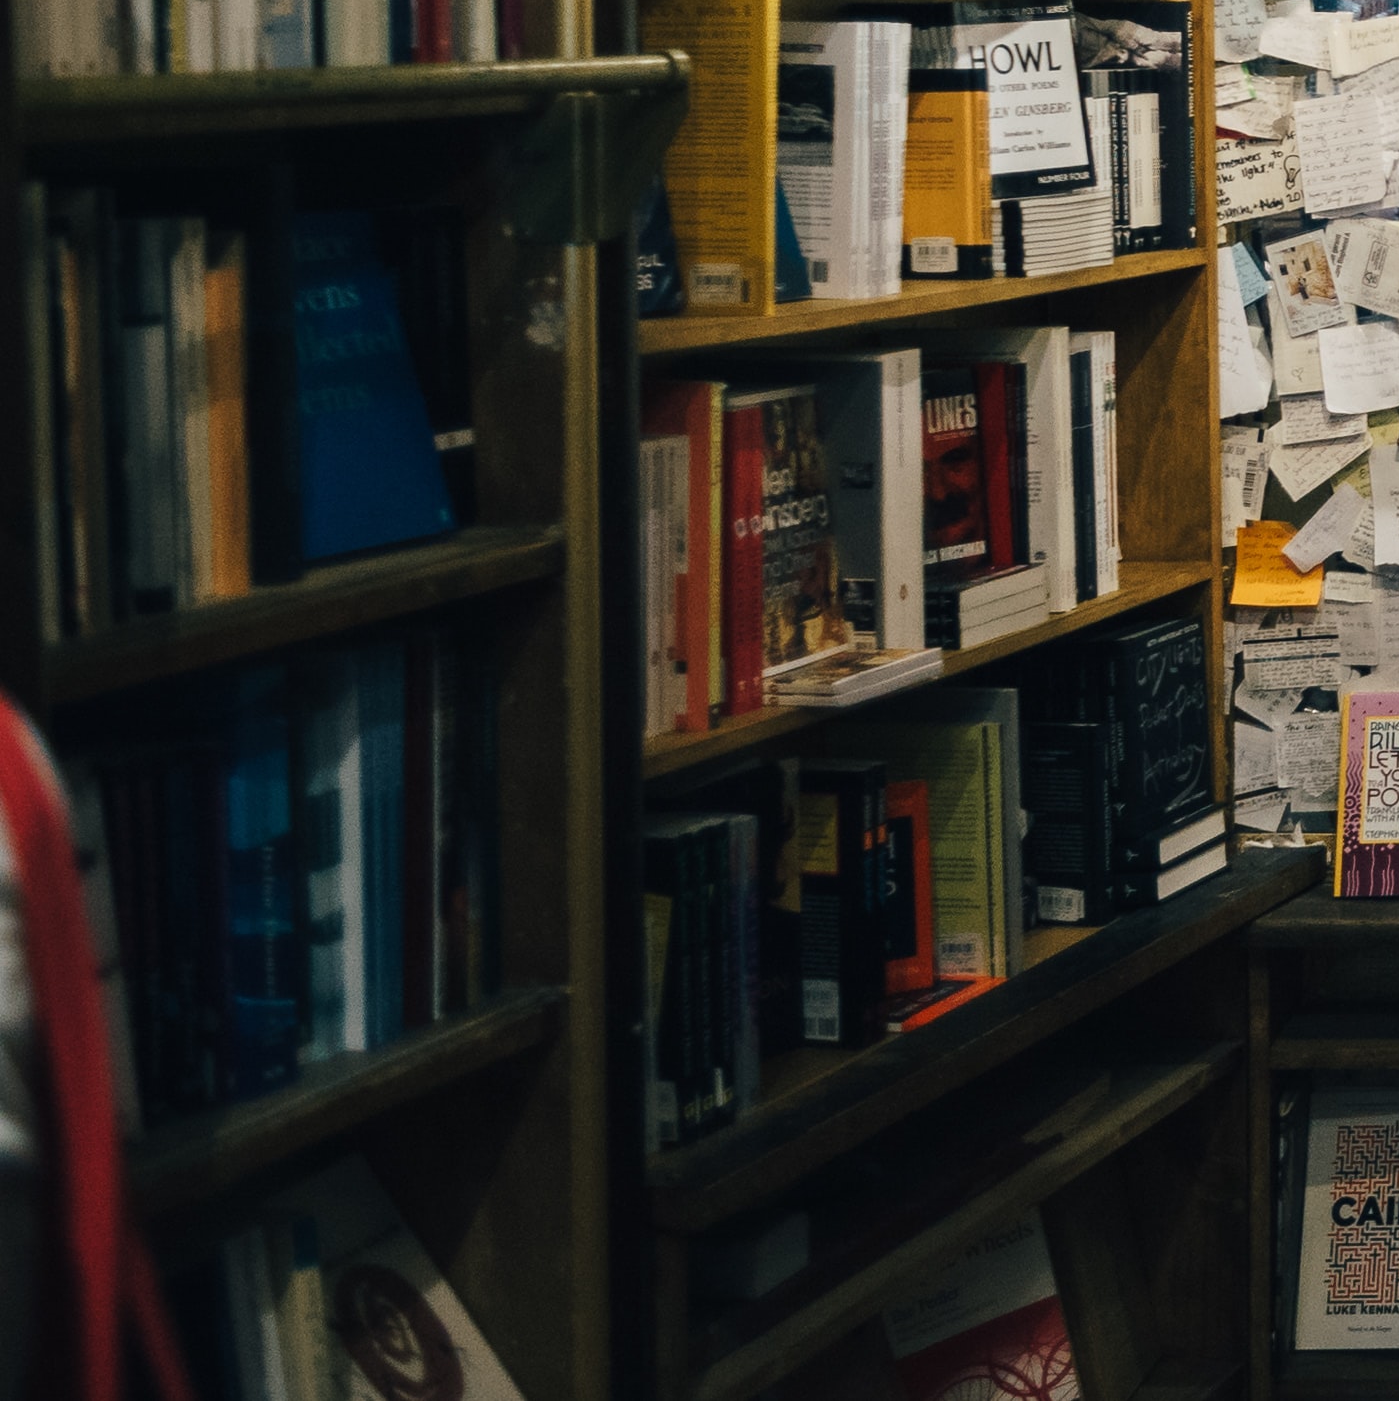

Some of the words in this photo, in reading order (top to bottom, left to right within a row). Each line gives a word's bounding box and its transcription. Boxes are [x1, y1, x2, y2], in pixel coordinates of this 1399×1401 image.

[969, 40, 1062, 75] HOWL
[1032, 80, 1059, 90] POEMS
[1015, 101, 1072, 117] GINSBERG
[1038, 174, 1069, 184] NUMBER
[1070, 171, 1090, 181] FOUR
[926, 394, 978, 434] LINES
[1366, 813, 1389, 822] WITH
[1326, 1304, 1357, 1317] LUKE
